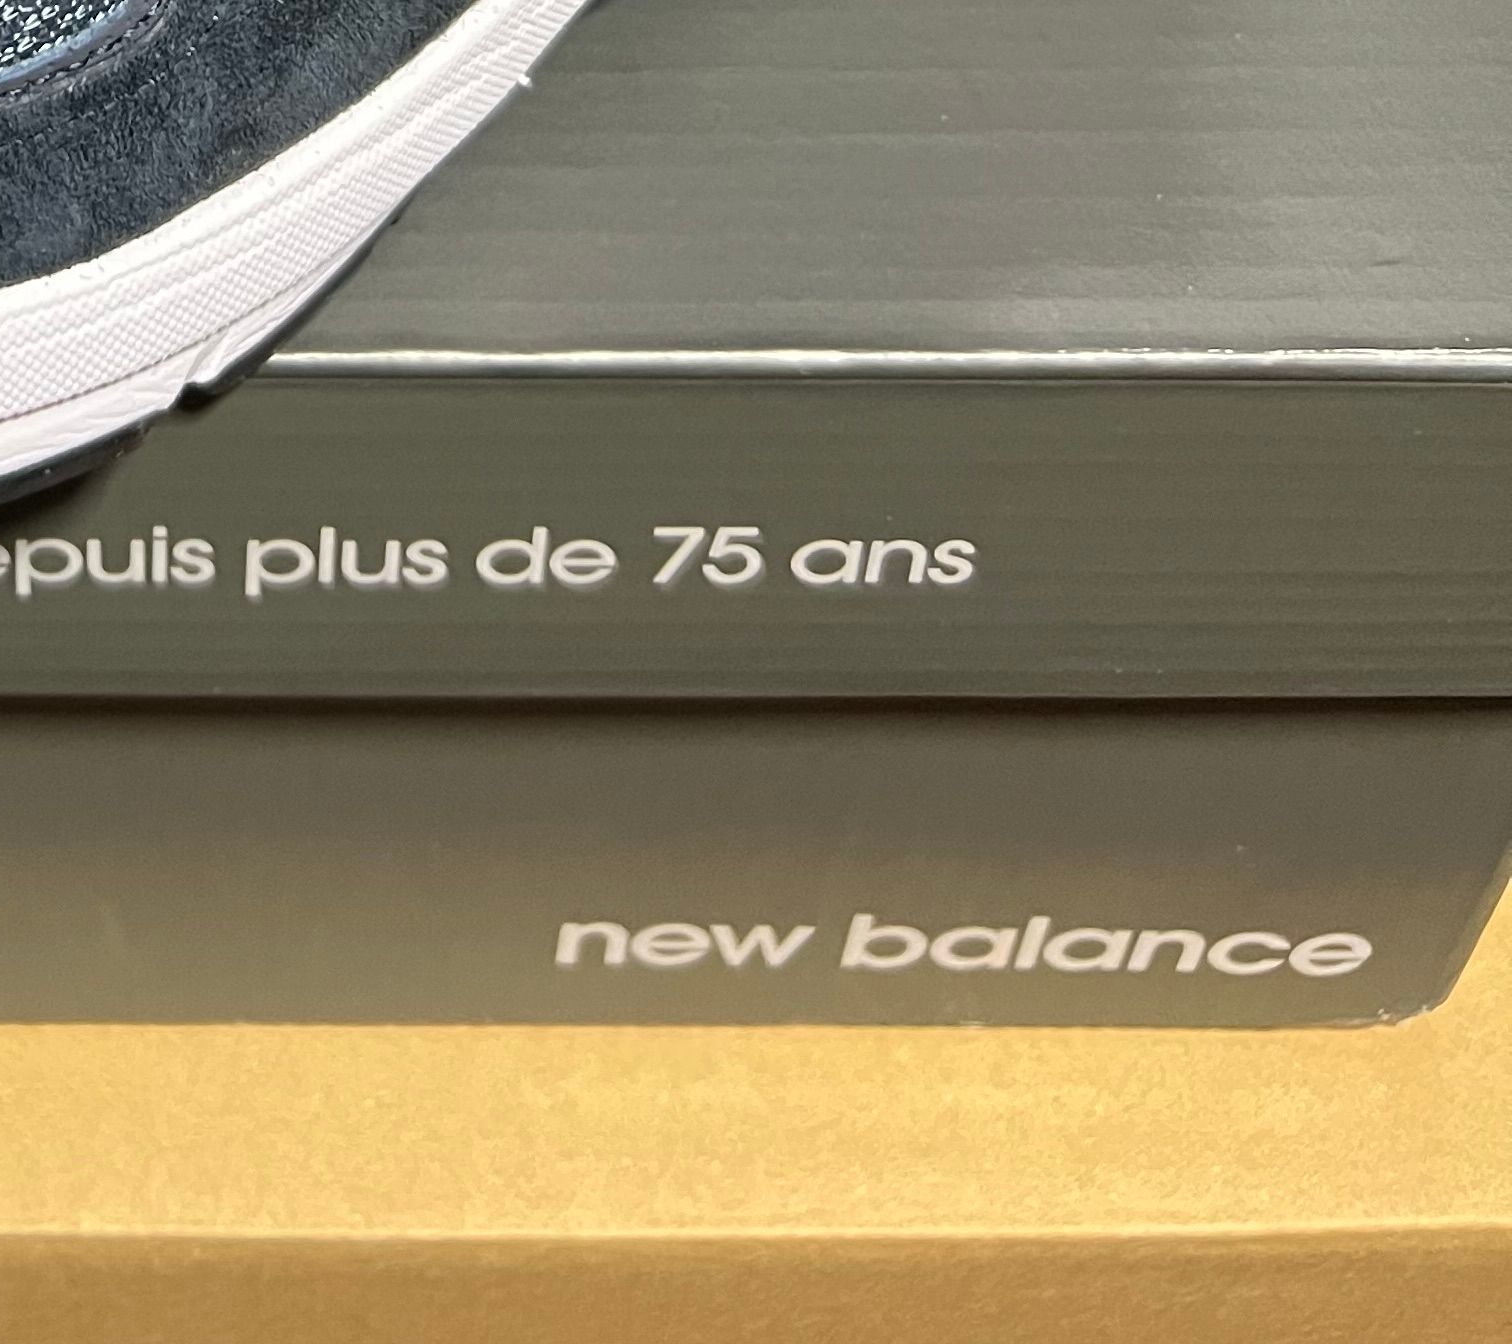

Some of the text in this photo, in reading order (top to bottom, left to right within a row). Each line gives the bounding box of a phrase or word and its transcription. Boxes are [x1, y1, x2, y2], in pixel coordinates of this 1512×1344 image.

[245, 525, 449, 597] plus
[475, 525, 619, 586] de
[651, 525, 763, 586] 75
[789, 538, 977, 586] ans
[554, 913, 1374, 976] new balance
